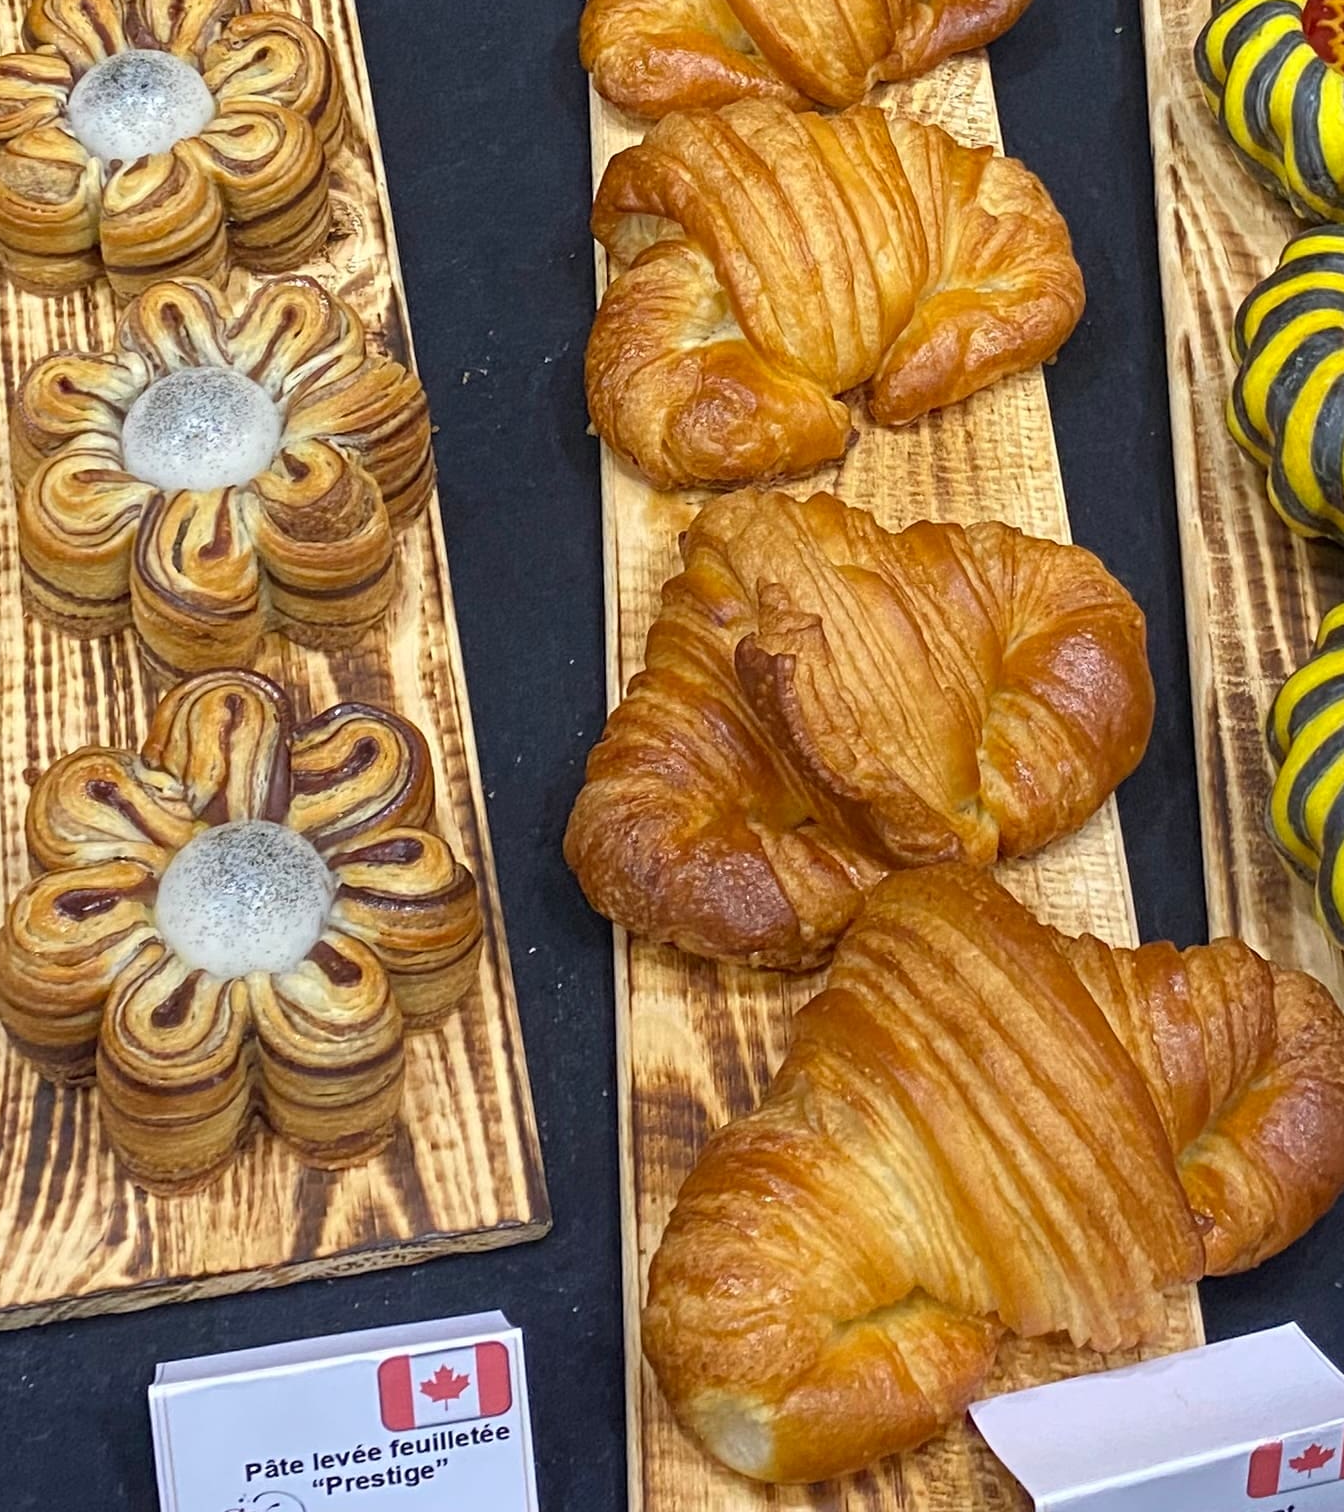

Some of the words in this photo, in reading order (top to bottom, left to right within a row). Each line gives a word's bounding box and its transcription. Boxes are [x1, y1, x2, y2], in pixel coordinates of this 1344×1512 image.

[245, 1458, 304, 1482] Pâte
[313, 1444, 382, 1472] levée
[390, 1424, 511, 1459] feuilletée
